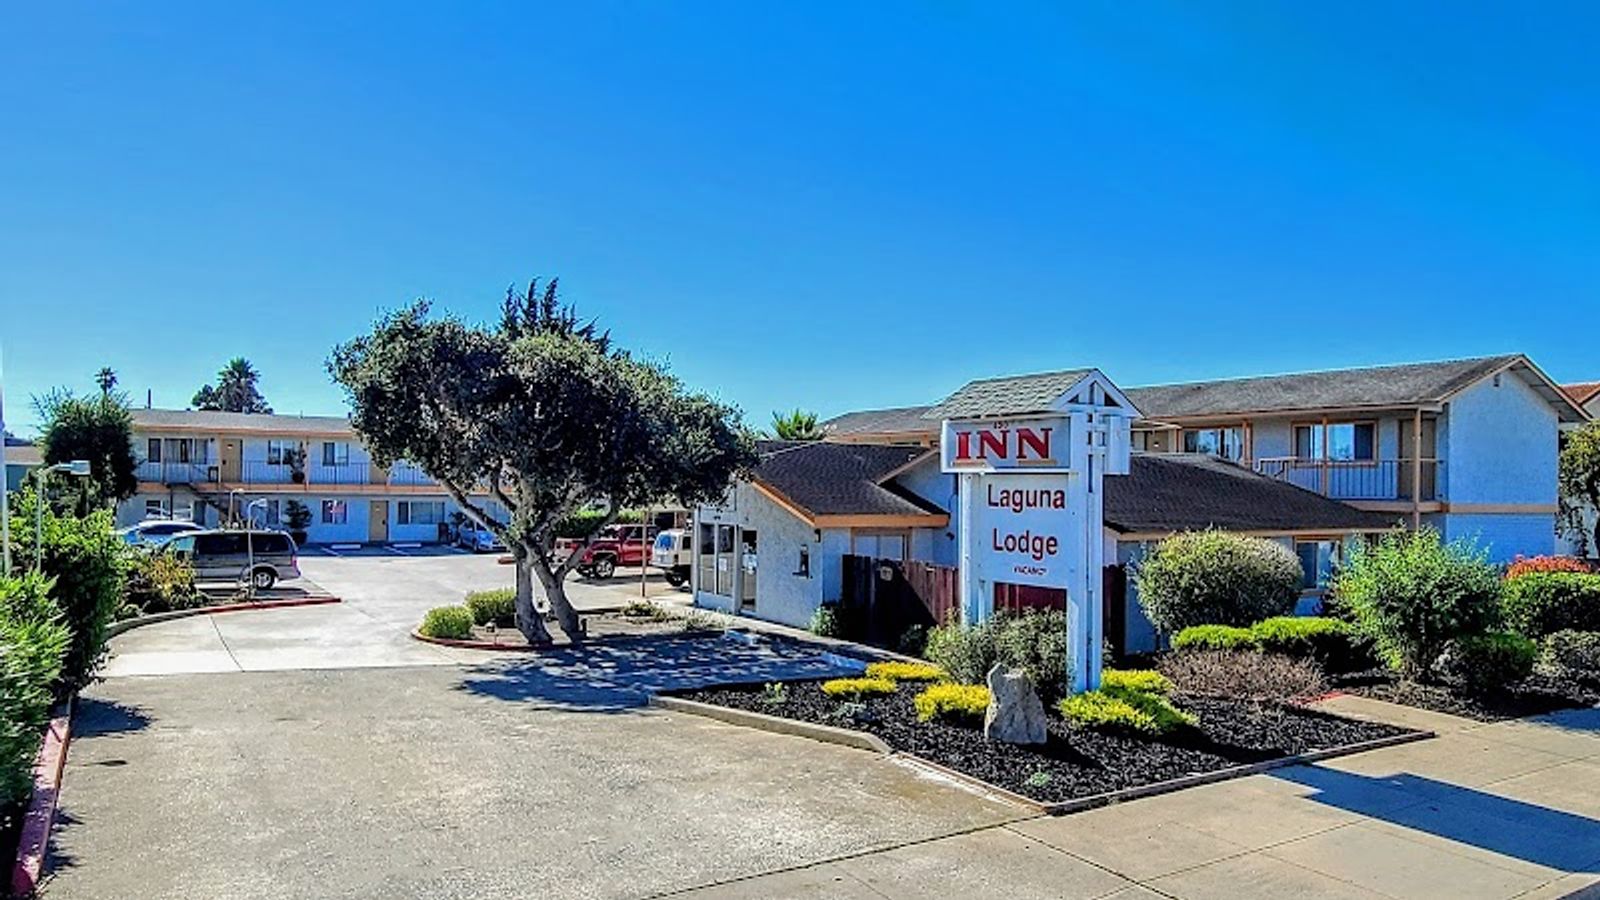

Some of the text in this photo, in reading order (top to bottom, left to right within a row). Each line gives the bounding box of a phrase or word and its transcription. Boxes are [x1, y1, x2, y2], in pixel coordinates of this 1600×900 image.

[956, 428, 1053, 460] INN
[988, 484, 1066, 513] Laguna
[993, 528, 1059, 561] Lodge
